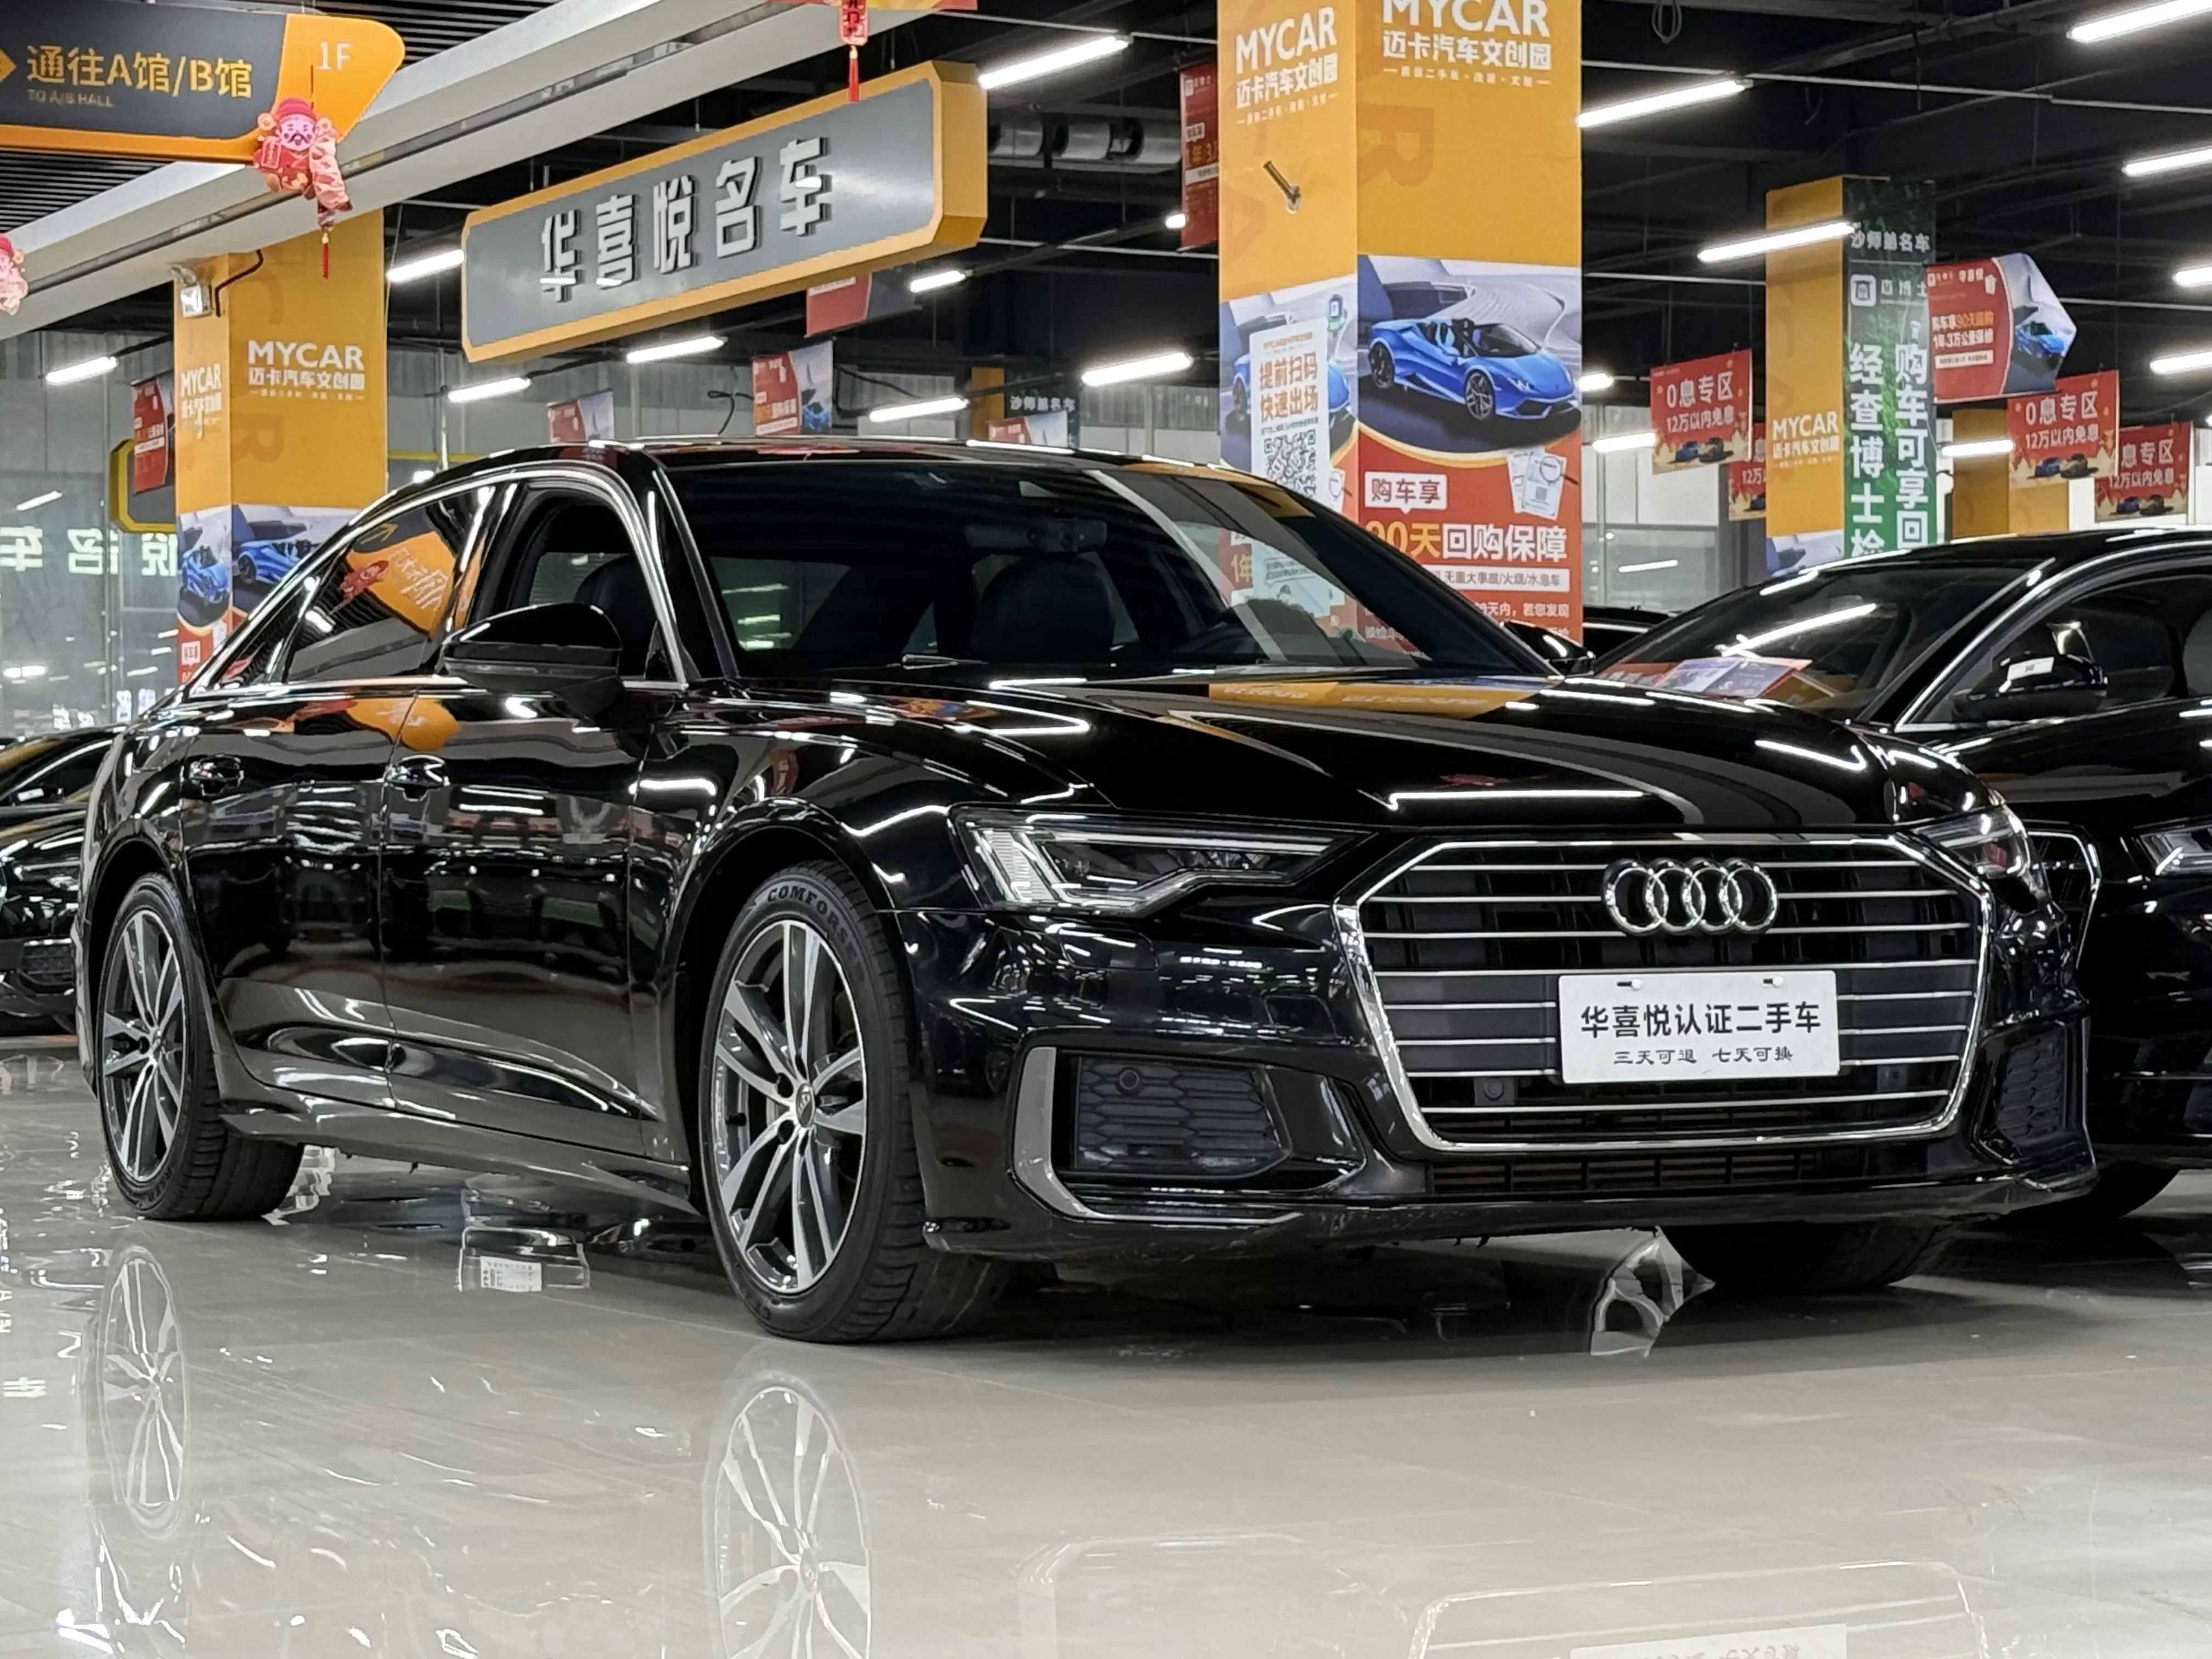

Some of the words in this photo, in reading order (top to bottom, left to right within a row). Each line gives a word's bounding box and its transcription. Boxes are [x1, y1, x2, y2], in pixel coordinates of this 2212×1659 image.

[1383, 0, 1550, 37] MYCAR
[316, 41, 353, 71] 1F
[1235, 7, 1338, 75] MYCAR
[1383, 29, 1552, 71] 迈卡汽车文创园
[26, 45, 252, 98] 通往A馆/B馆
[1235, 52, 1338, 110] 迈卡汽车文创园
[27, 89, 46, 102] TO
[77, 94, 114, 108] HALL
[540, 136, 831, 302] 华喜悦名车
[248, 340, 365, 370] MYCAR
[1260, 351, 1318, 391] 提前扫码
[180, 363, 222, 397] MYCAR
[1667, 371, 1734, 409] 0息专区
[1261, 384, 1318, 424] 快速出场
[2025, 390, 2098, 426] 0息专区
[1772, 410, 1839, 442] MYCAR
[1895, 343, 1929, 549] 购车可享回
[1370, 478, 1441, 505] 购车享
[1742, 467, 1766, 486] 12万
[1581, 1001, 1821, 1039] 华喜悦认证二手车
